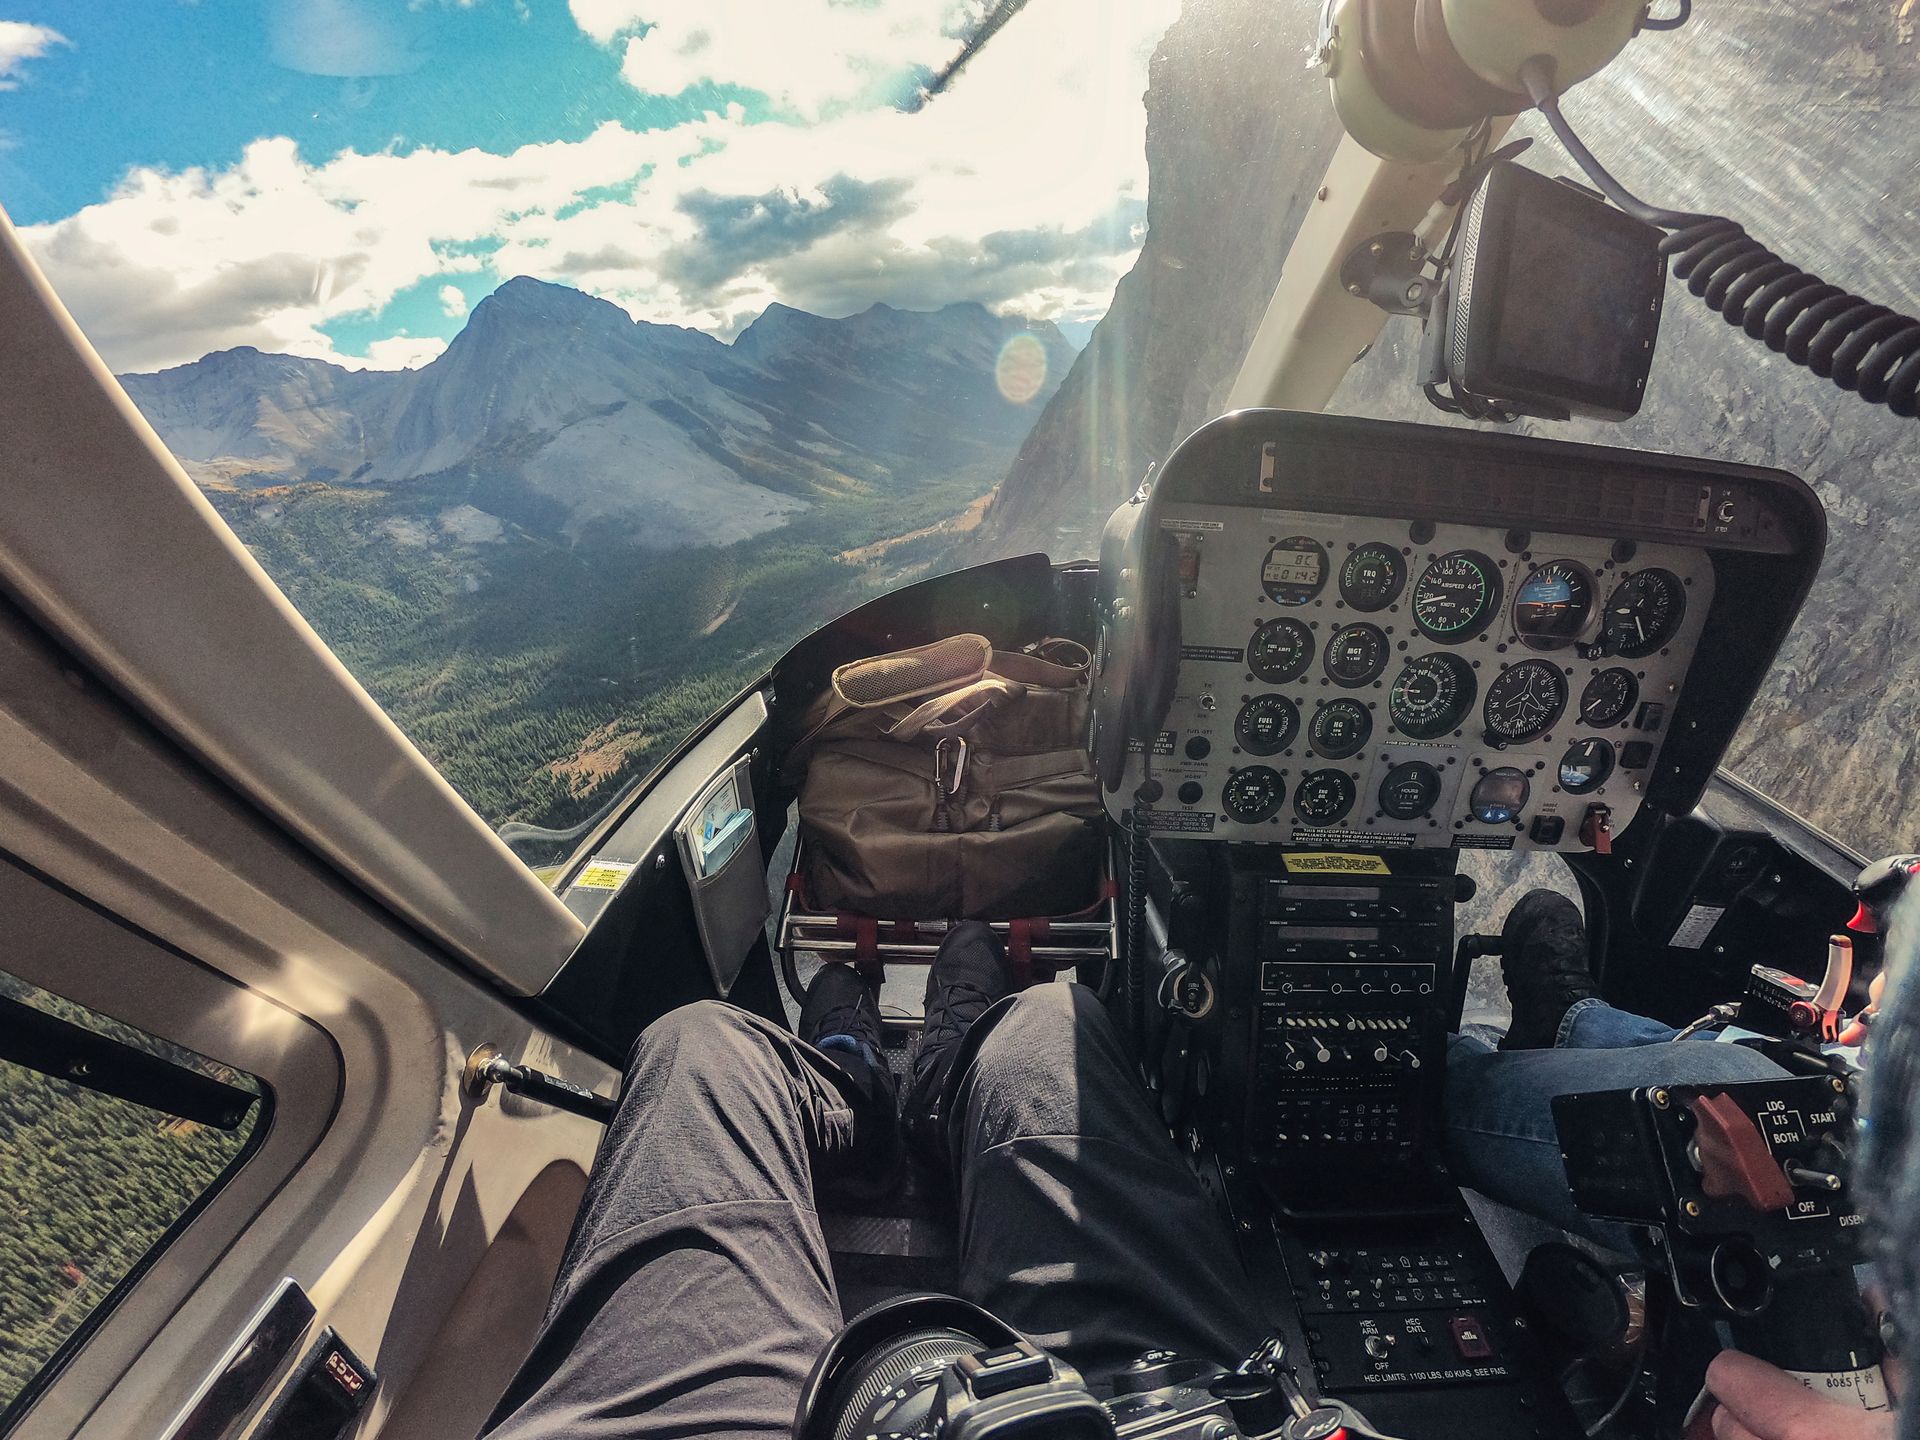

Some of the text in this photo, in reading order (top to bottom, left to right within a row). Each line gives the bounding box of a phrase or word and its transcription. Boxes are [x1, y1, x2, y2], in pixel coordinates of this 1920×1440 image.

[1519, 671, 1525, 679] E
[1766, 1101, 1786, 1111] LDG
[1772, 1114, 1789, 1126] LTS
[1810, 1112, 1837, 1124] START
[1773, 1132, 1799, 1144] BOTH
[1798, 1201, 1815, 1212] OFF
[1405, 1318, 1420, 1326] HEC
[1362, 1327, 1379, 1335] ARM
[1147, 1352, 1163, 1360] OFF
[1375, 1362, 1389, 1370] OFF
[329, 1354, 361, 1390] PULL
[1364, 1374, 1381, 1383] HEC
[1409, 1372, 1427, 1380] 1100
[1445, 1370, 1454, 1378] 60
[1475, 1368, 1490, 1376] SEE
